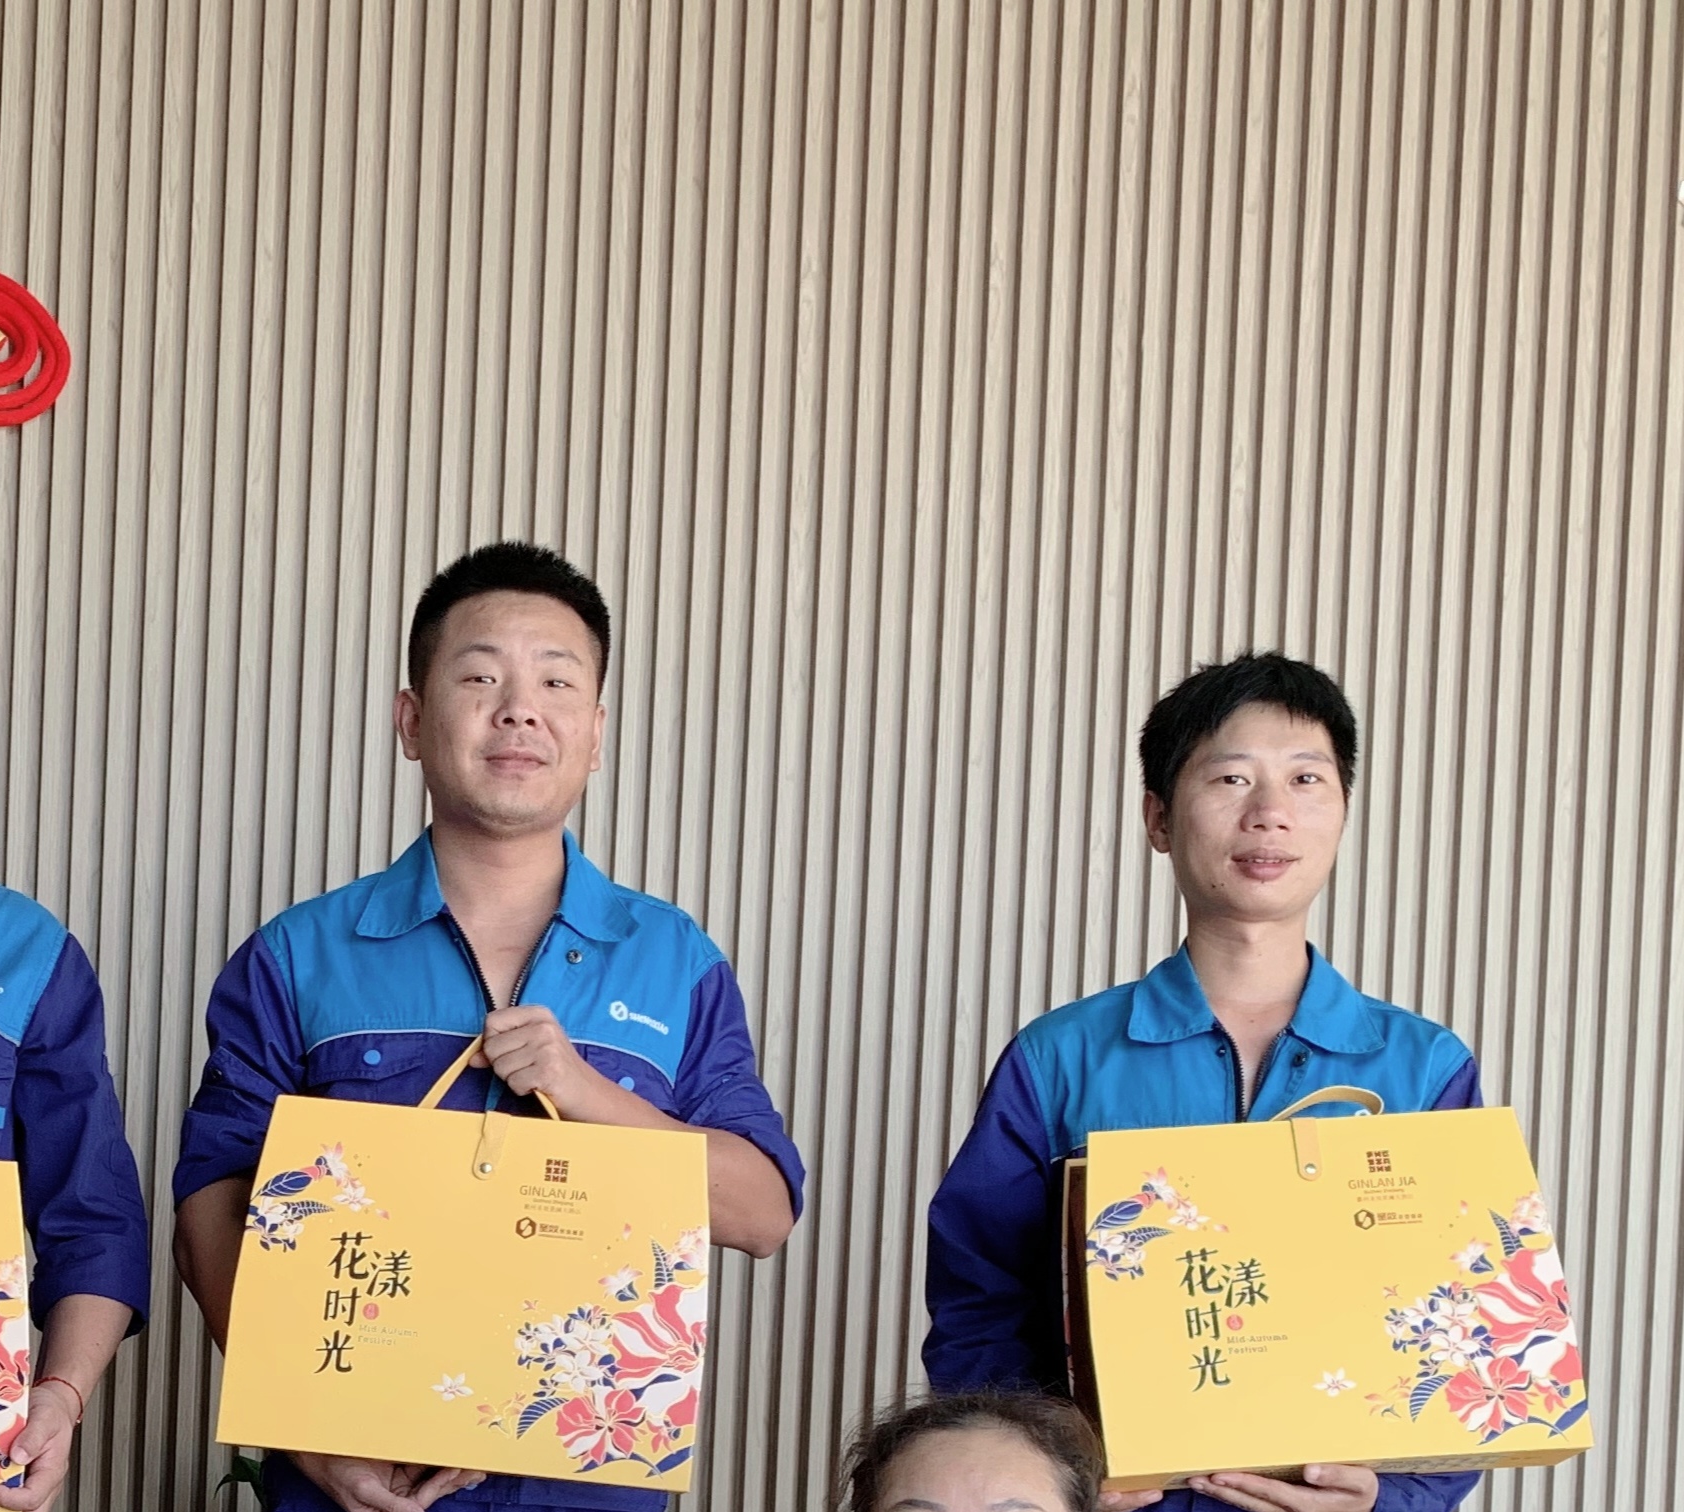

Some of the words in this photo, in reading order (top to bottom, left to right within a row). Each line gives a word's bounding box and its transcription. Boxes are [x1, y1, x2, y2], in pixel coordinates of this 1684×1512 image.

[1348, 1178, 1394, 1189] GINLAN
[1399, 1176, 1417, 1186] JIA
[519, 1186, 566, 1199] GINLAN
[570, 1190, 588, 1201] JIA
